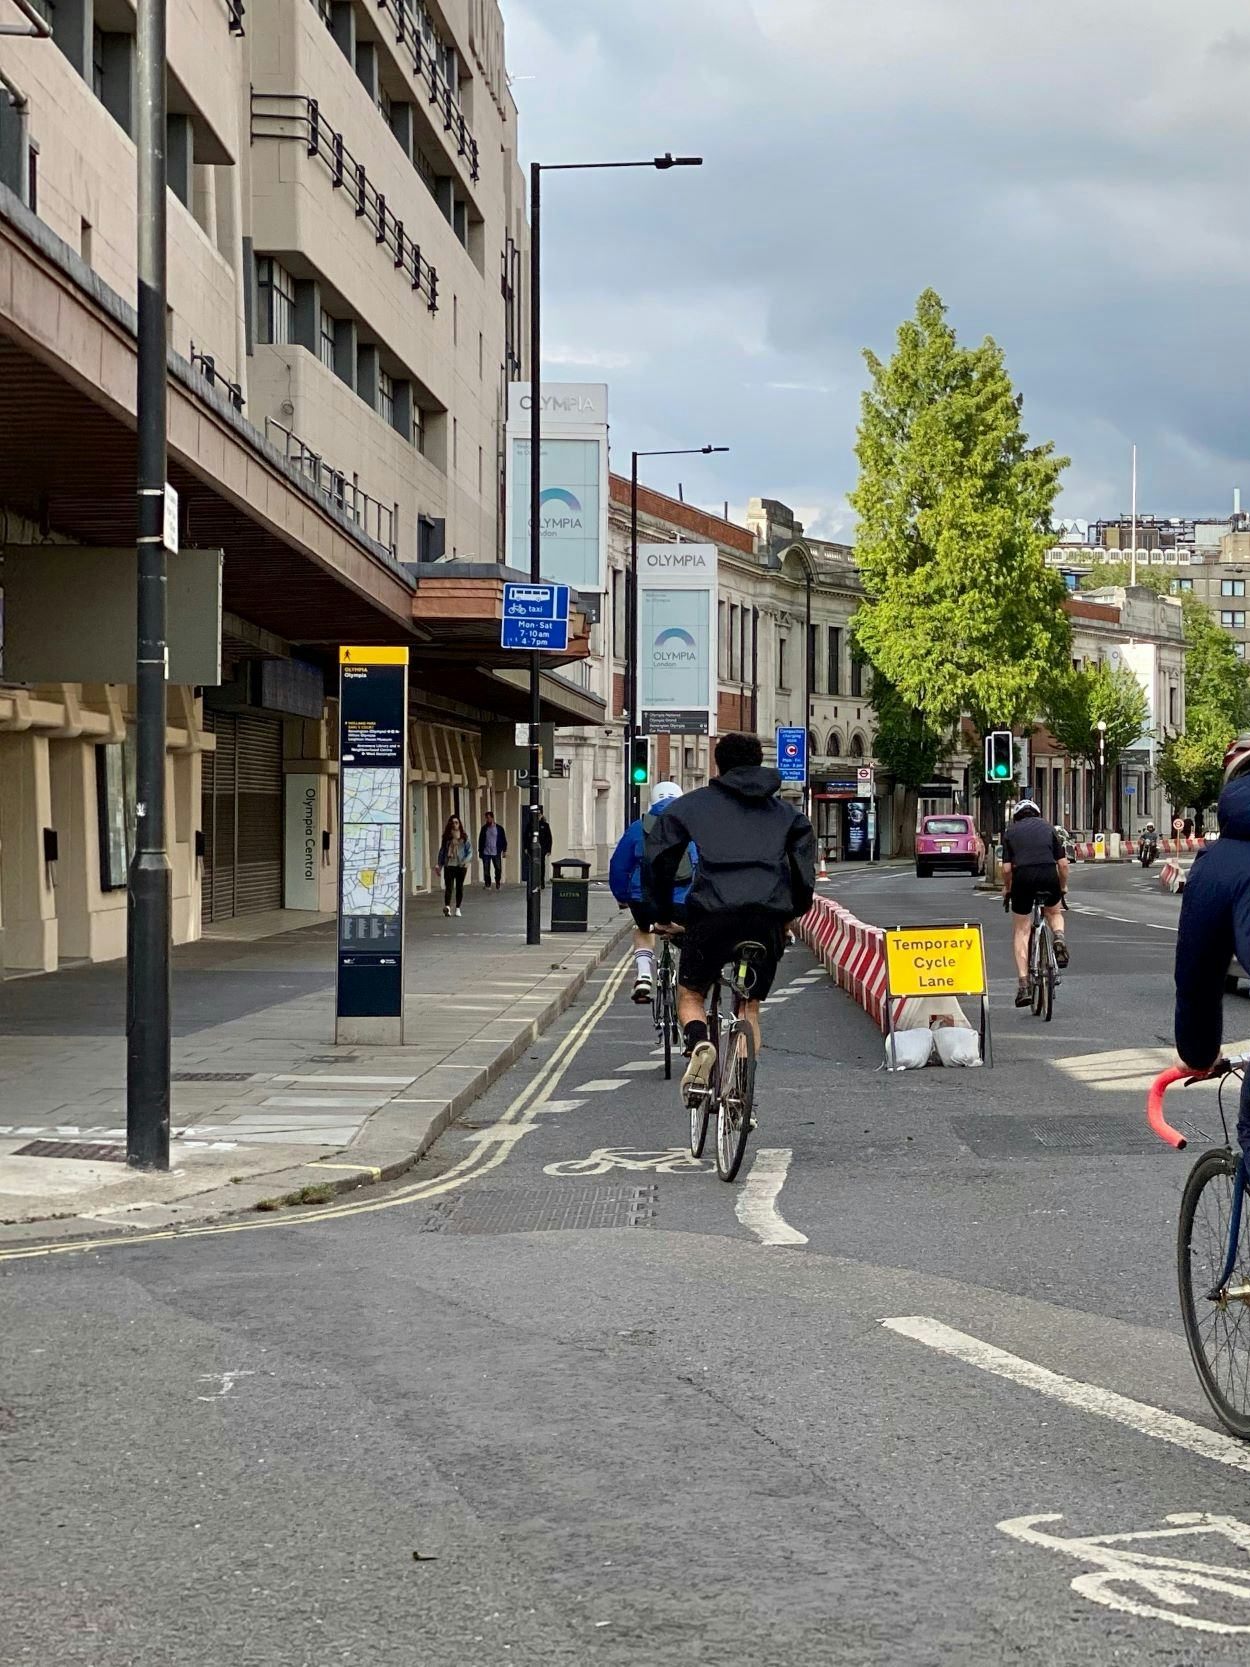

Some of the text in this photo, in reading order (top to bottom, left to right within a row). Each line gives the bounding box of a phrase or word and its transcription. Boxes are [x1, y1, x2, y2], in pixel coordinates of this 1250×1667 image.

[520, 396, 594, 411] OYMPIA
[528, 518, 582, 528] LYMPIA
[647, 555, 706, 567] OLYMPIA
[528, 605, 543, 613] taxi
[653, 652, 696, 660] OLYMPIA
[787, 745, 796, 755] C
[303, 788, 316, 881] Olympia Central
[893, 939, 974, 951] Temporary
[913, 956, 956, 970] Cycle
[919, 976, 954, 987] Lane
